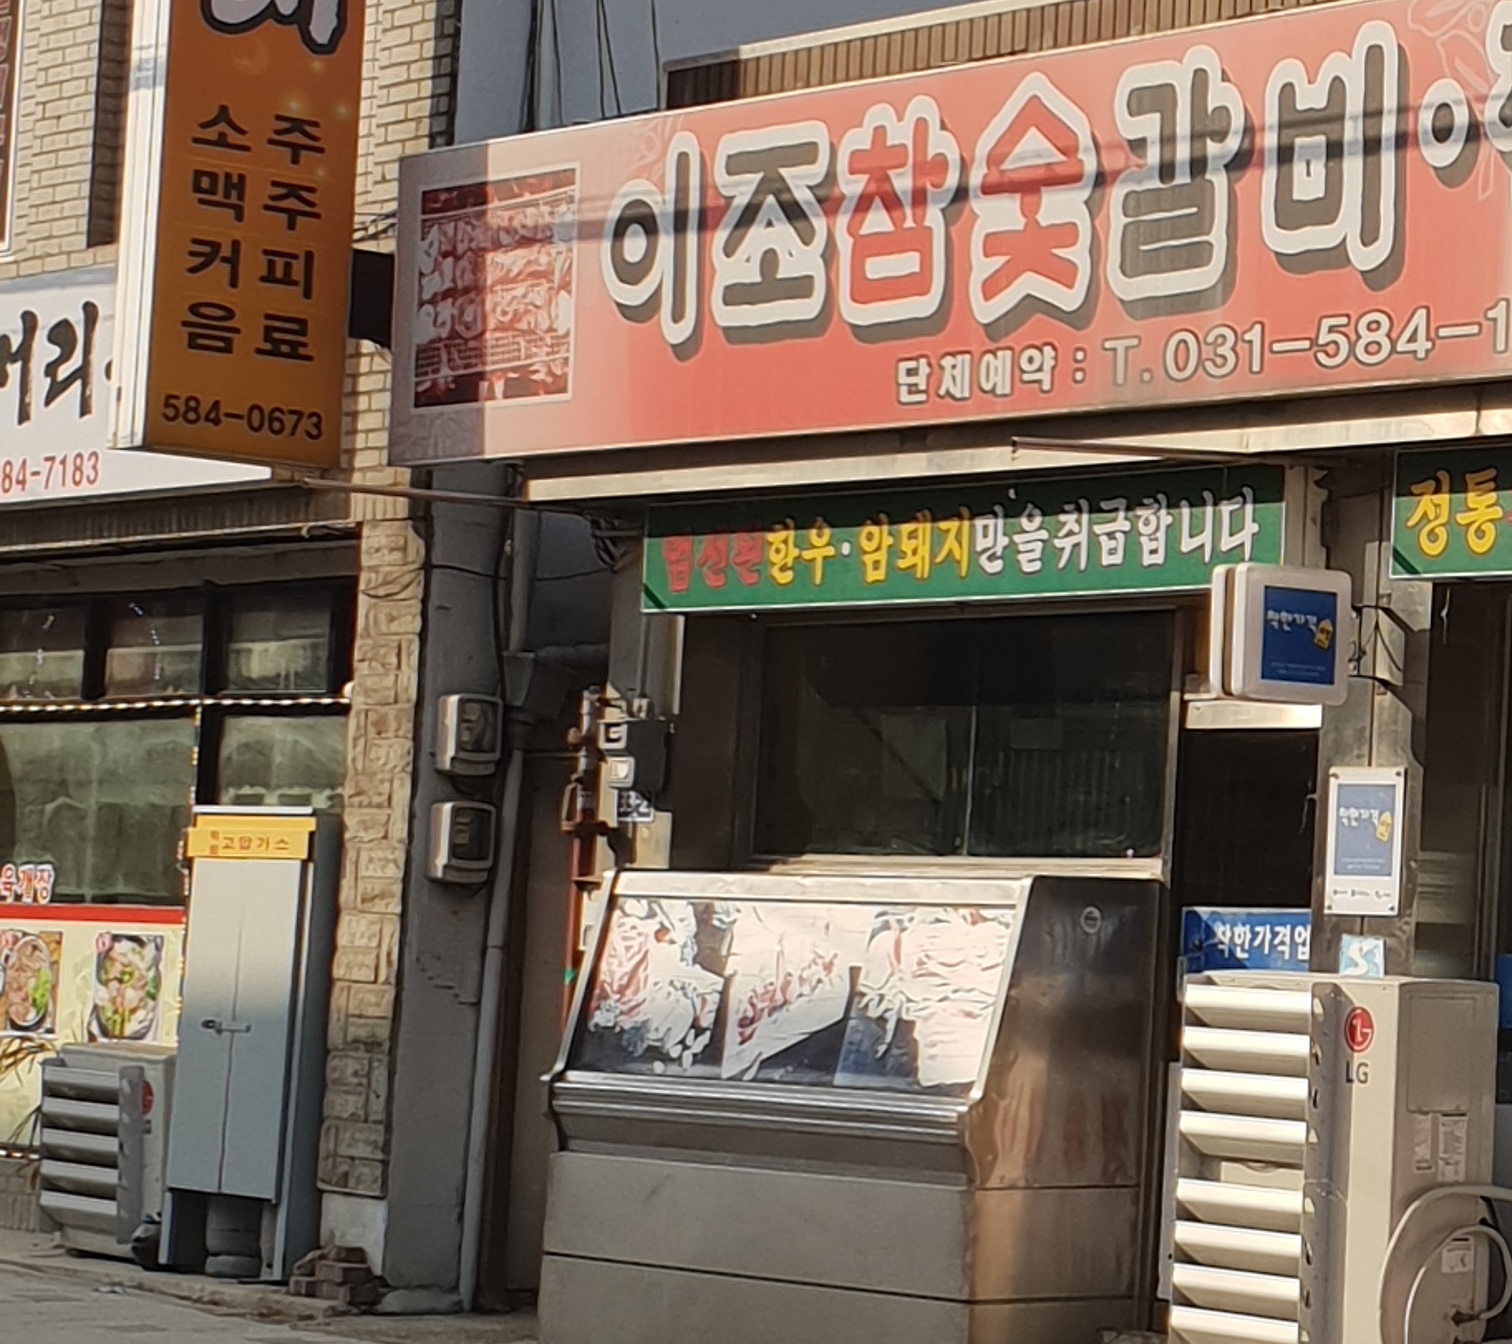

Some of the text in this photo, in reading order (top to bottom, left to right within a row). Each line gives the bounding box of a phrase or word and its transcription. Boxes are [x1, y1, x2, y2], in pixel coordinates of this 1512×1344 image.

[190, 103, 326, 166] 소주
[190, 167, 322, 232] 맥주
[185, 236, 315, 299] 커피
[180, 301, 316, 362] 음료
[161, 393, 324, 441] 584-0673
[0, 450, 99, 494] 84-7183
[1345, 1060, 1369, 1085] LG
